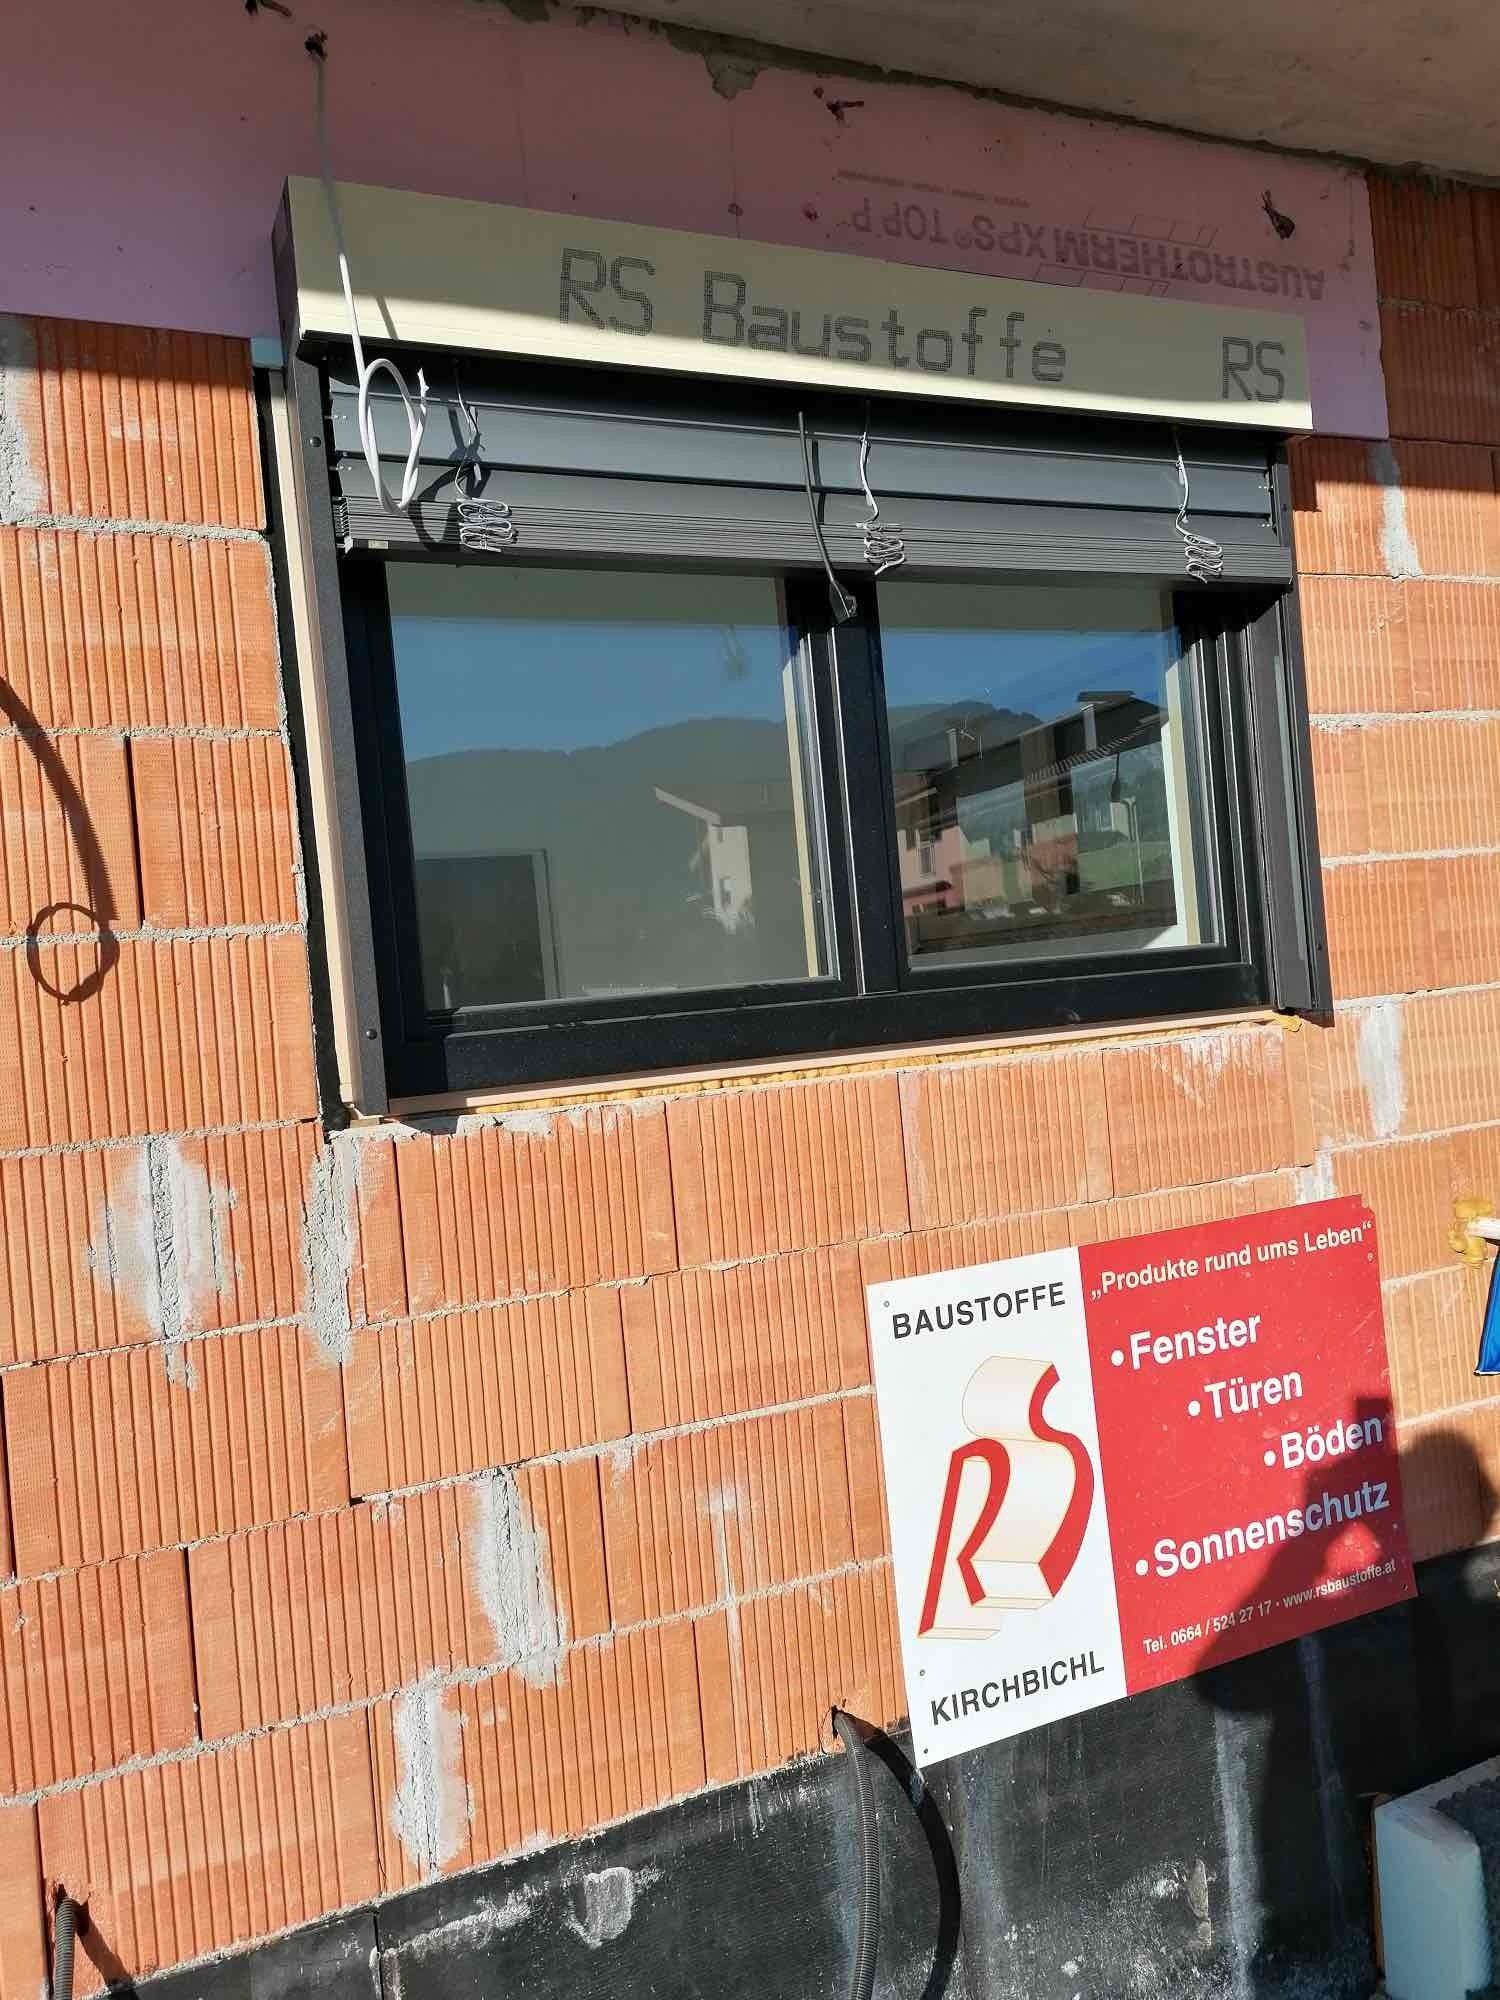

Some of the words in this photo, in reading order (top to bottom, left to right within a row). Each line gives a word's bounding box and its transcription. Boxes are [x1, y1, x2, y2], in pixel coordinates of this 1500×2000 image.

[1053, 228, 1325, 300] AUSTROTHERM
[559, 247, 656, 337] RS
[702, 269, 1066, 382] Baustoffe
[1221, 335, 1285, 403] RS
[1204, 1246, 1251, 1274] rund
[1257, 1238, 1299, 1263] ums
[892, 1281, 1066, 1339] BAUSTOFFE
[1129, 1314, 1262, 1370] Fenster
[1204, 1370, 1303, 1419] Türen
[1281, 1417, 1383, 1469] Böden
[1154, 1480, 1390, 1578] Sonnenschutz
[1143, 1638, 1168, 1654] Tel.
[1171, 1623, 1202, 1647] 0664
[1213, 1614, 1235, 1633] 524
[1239, 1606, 1254, 1624] 27
[1257, 1600, 1273, 1618] 17
[1283, 1558, 1397, 1609] www.rsbaustoffe.at
[931, 1650, 1105, 1726] KIRCHBICHL
